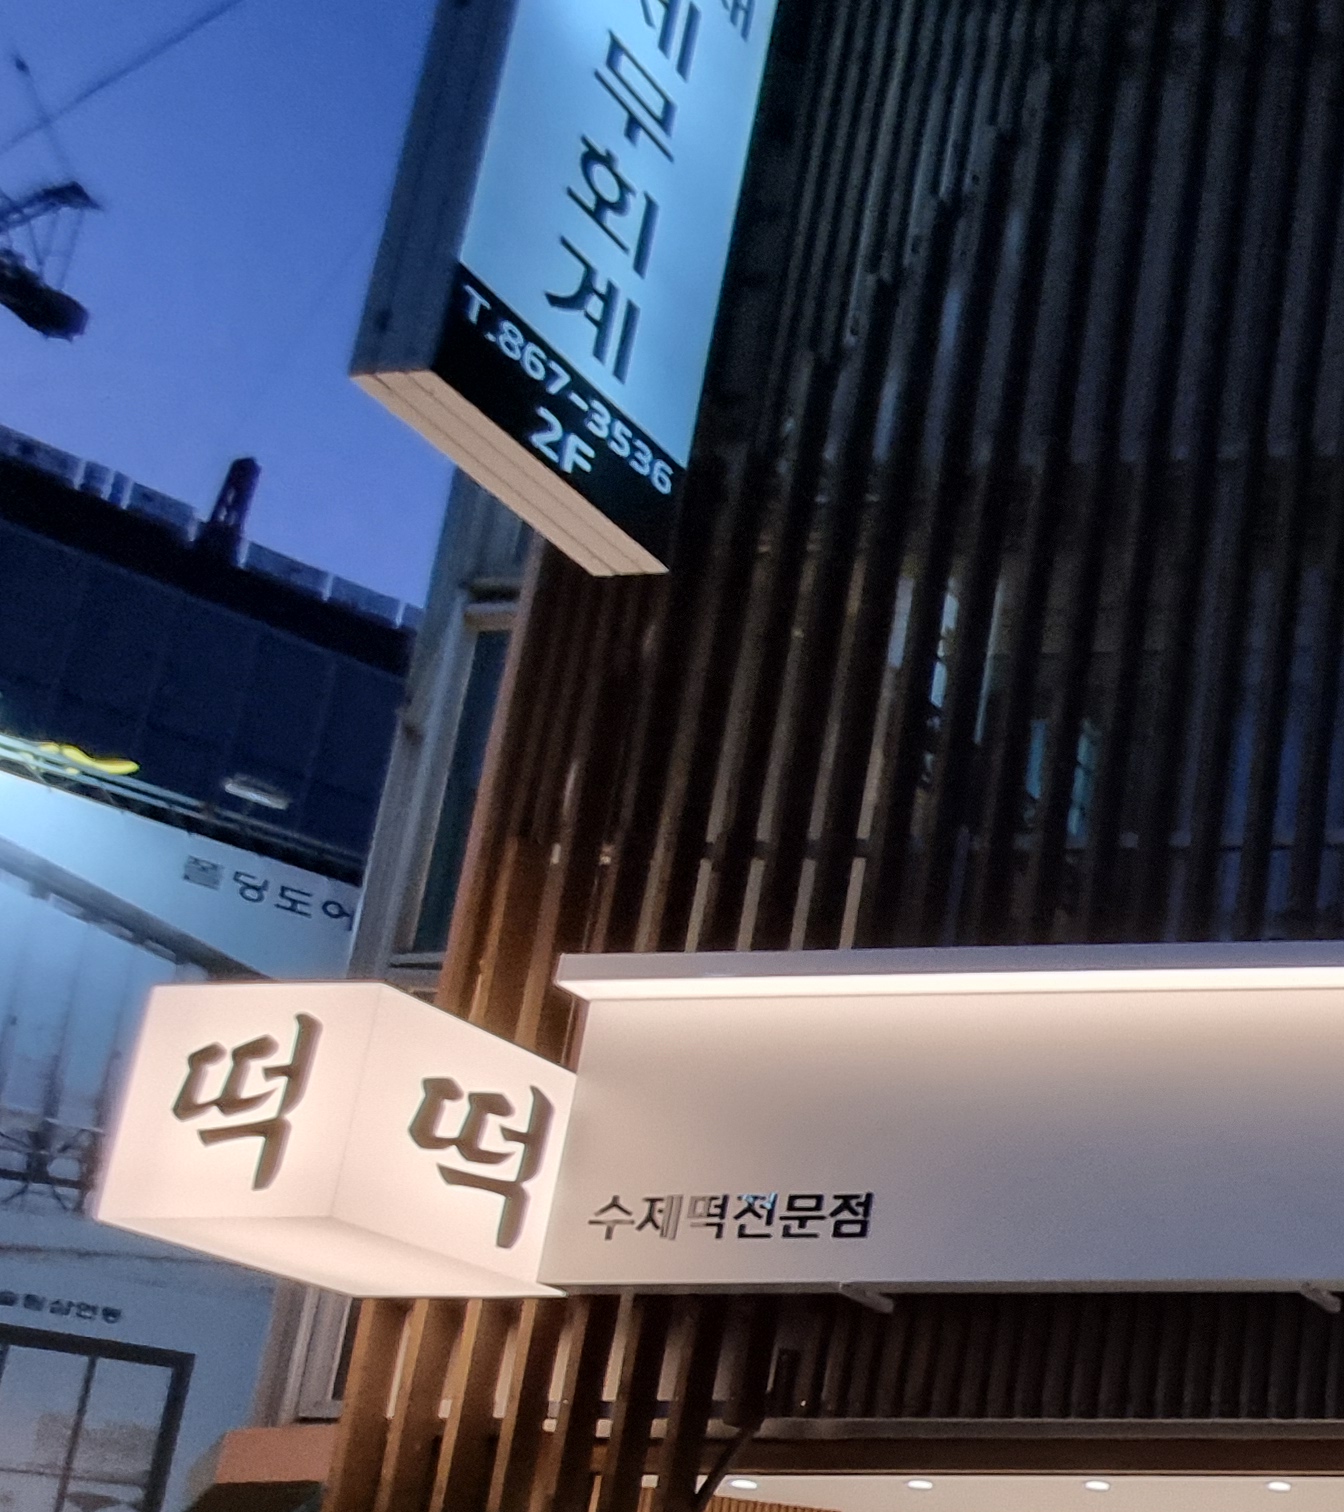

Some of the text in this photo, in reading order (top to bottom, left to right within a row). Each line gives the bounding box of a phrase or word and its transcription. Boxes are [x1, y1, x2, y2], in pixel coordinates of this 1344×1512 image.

[463, 284, 675, 495] T.867-3536
[529, 405, 596, 475] 2F
[171, 1011, 324, 1192] 떡
[407, 1075, 557, 1249] 떡
[587, 1191, 874, 1241] 수제떡전문점
